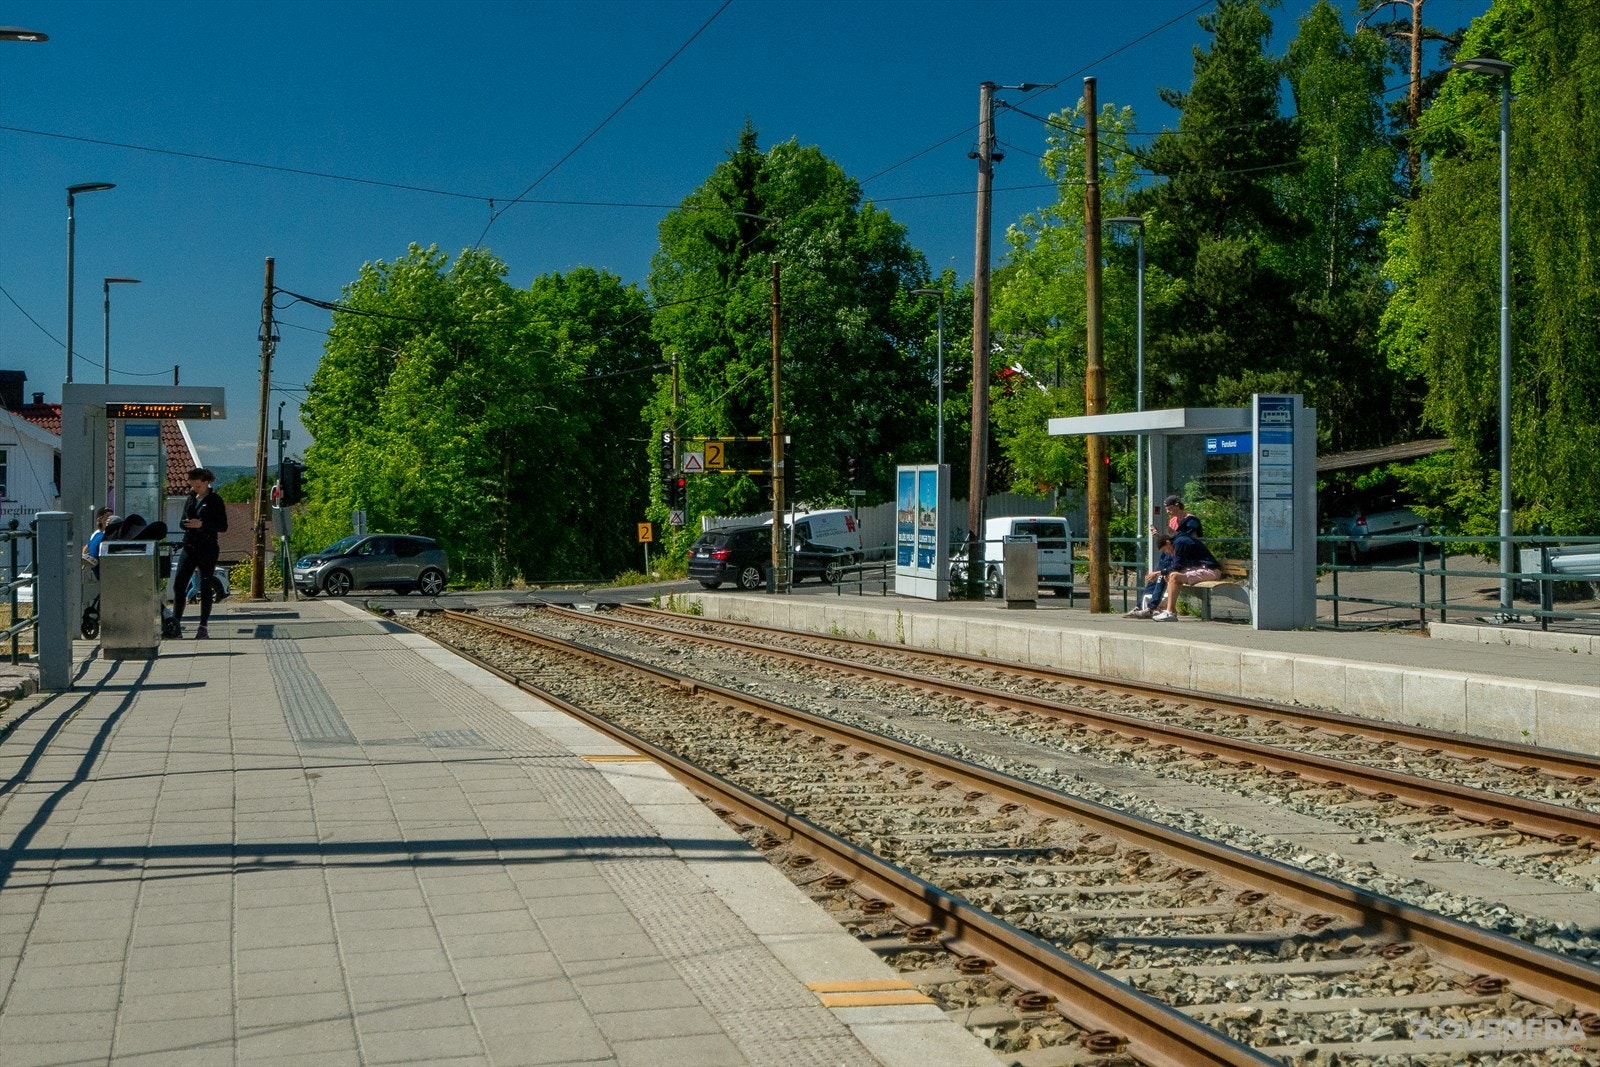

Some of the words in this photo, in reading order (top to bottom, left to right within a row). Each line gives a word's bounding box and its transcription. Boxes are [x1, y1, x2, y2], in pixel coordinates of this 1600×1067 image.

[663, 432, 671, 443] S
[708, 445, 721, 465] 2
[641, 526, 649, 540] 2
